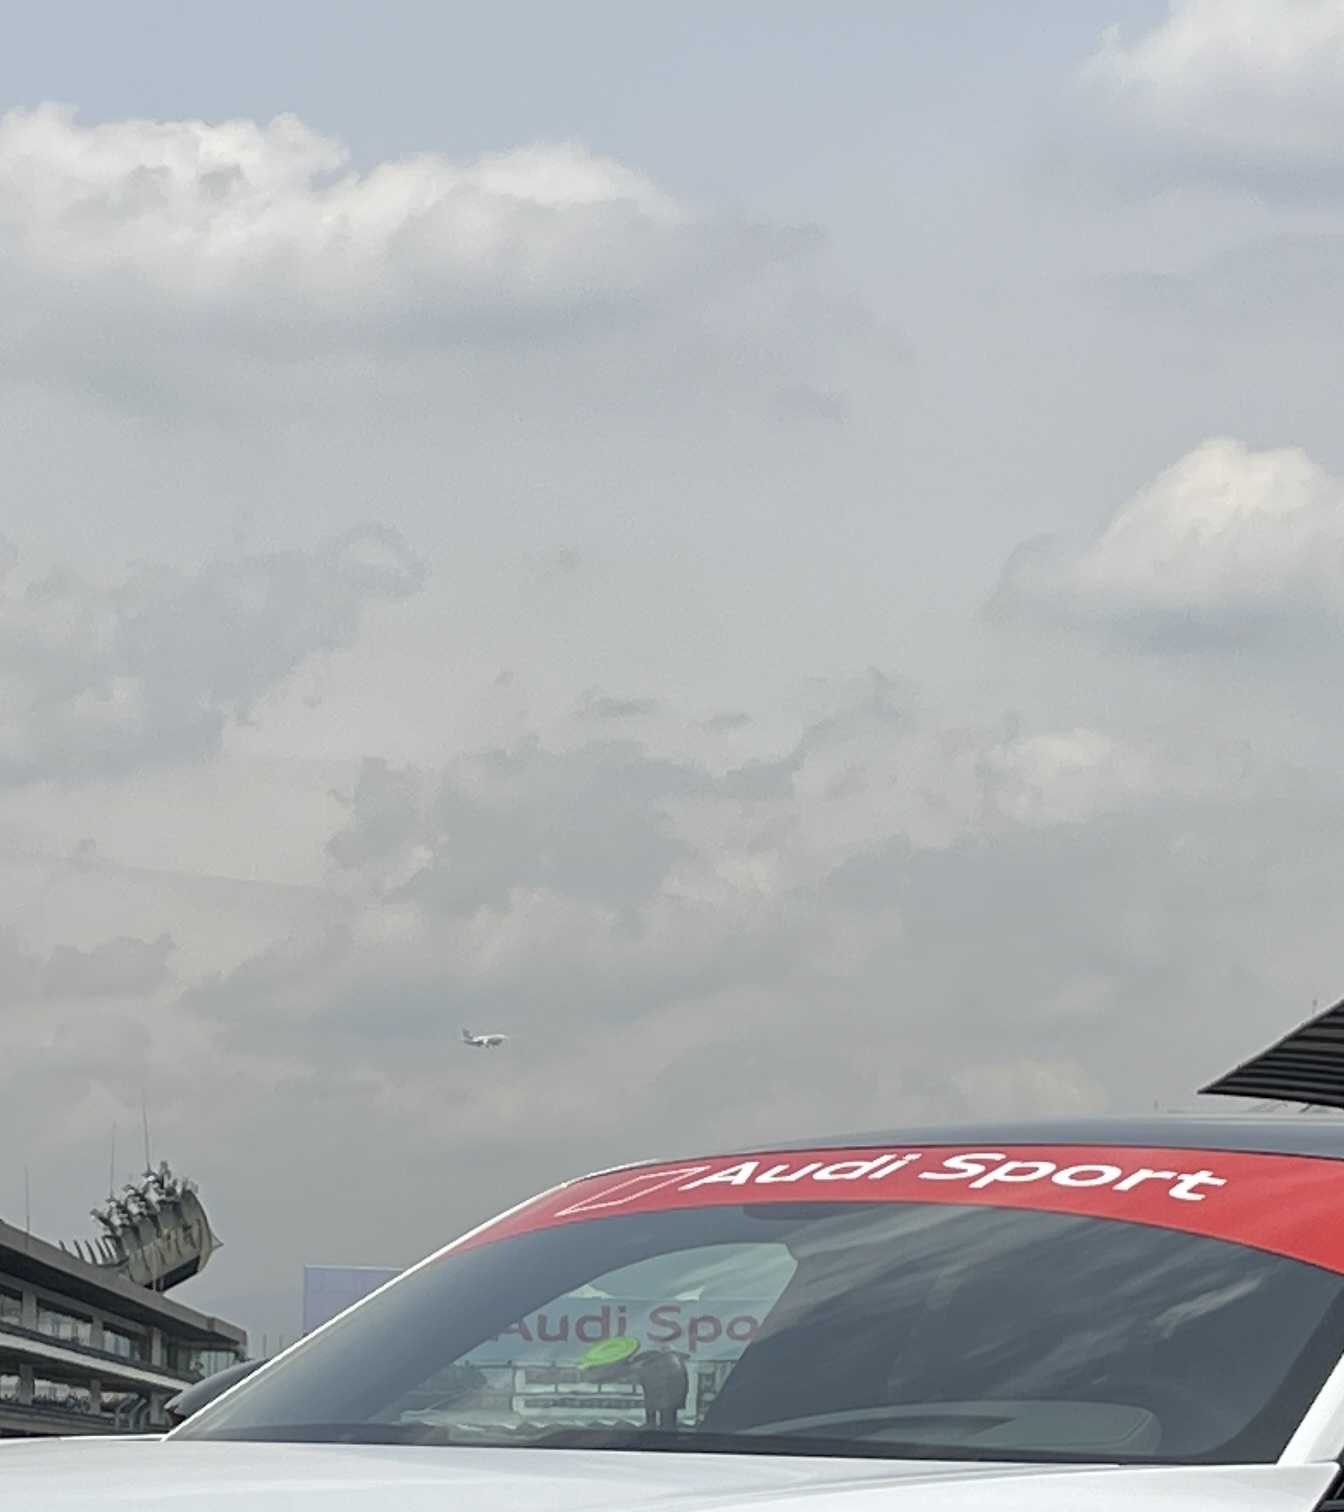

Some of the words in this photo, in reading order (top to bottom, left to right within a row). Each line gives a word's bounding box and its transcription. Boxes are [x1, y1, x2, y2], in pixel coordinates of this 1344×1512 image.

[677, 1152, 923, 1192] Audi
[917, 1152, 1228, 1201] Sport
[646, 1304, 762, 1352] Spo
